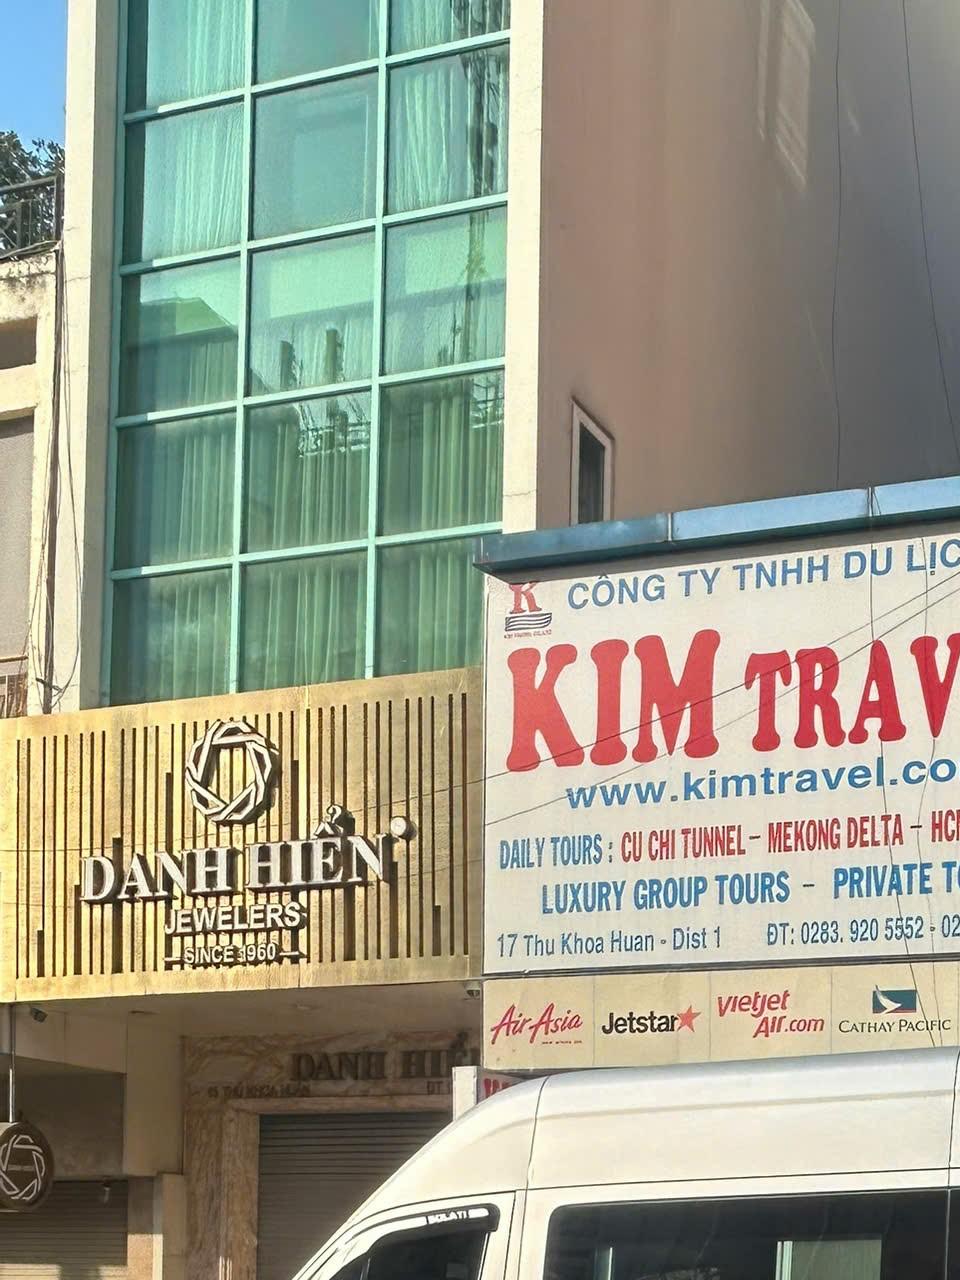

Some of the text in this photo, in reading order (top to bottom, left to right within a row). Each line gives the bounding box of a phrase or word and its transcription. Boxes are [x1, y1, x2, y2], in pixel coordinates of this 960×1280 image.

[567, 571, 666, 610] CÔNG
[677, 567, 721, 597] TY
[733, 554, 831, 594] TNHH
[844, 546, 893, 580] DU
[506, 628, 721, 773] KIM
[499, 836, 545, 870] DAILY
[550, 833, 603, 866] TOURS
[620, 831, 643, 863] CU
[648, 828, 676, 861] CHI
[681, 825, 746, 859] TUNNEL
[767, 818, 841, 854] MEKONG
[847, 813, 904, 849] DELTA
[81, 846, 234, 901] DANH
[541, 879, 627, 915] LUXURY
[633, 874, 708, 911] GROUP
[714, 870, 790, 905] TOURS
[832, 861, 933, 900] PRIVATE
[165, 902, 301, 935] JEWELERS
[497, 932, 518, 958] 17
[523, 934, 555, 957] Thu
[560, 931, 604, 955] Khoa
[610, 930, 655, 953] Huan
[672, 927, 707, 950] Dist
[713, 925, 721, 948] 1
[800, 920, 844, 945] 0283.
[850, 918, 879, 942] 920
[884, 916, 924, 941] 5552
[183, 943, 277, 965] SINCE 1960
[601, 1010, 679, 1035] Jetstar
[289, 1051, 388, 1081] DANH
